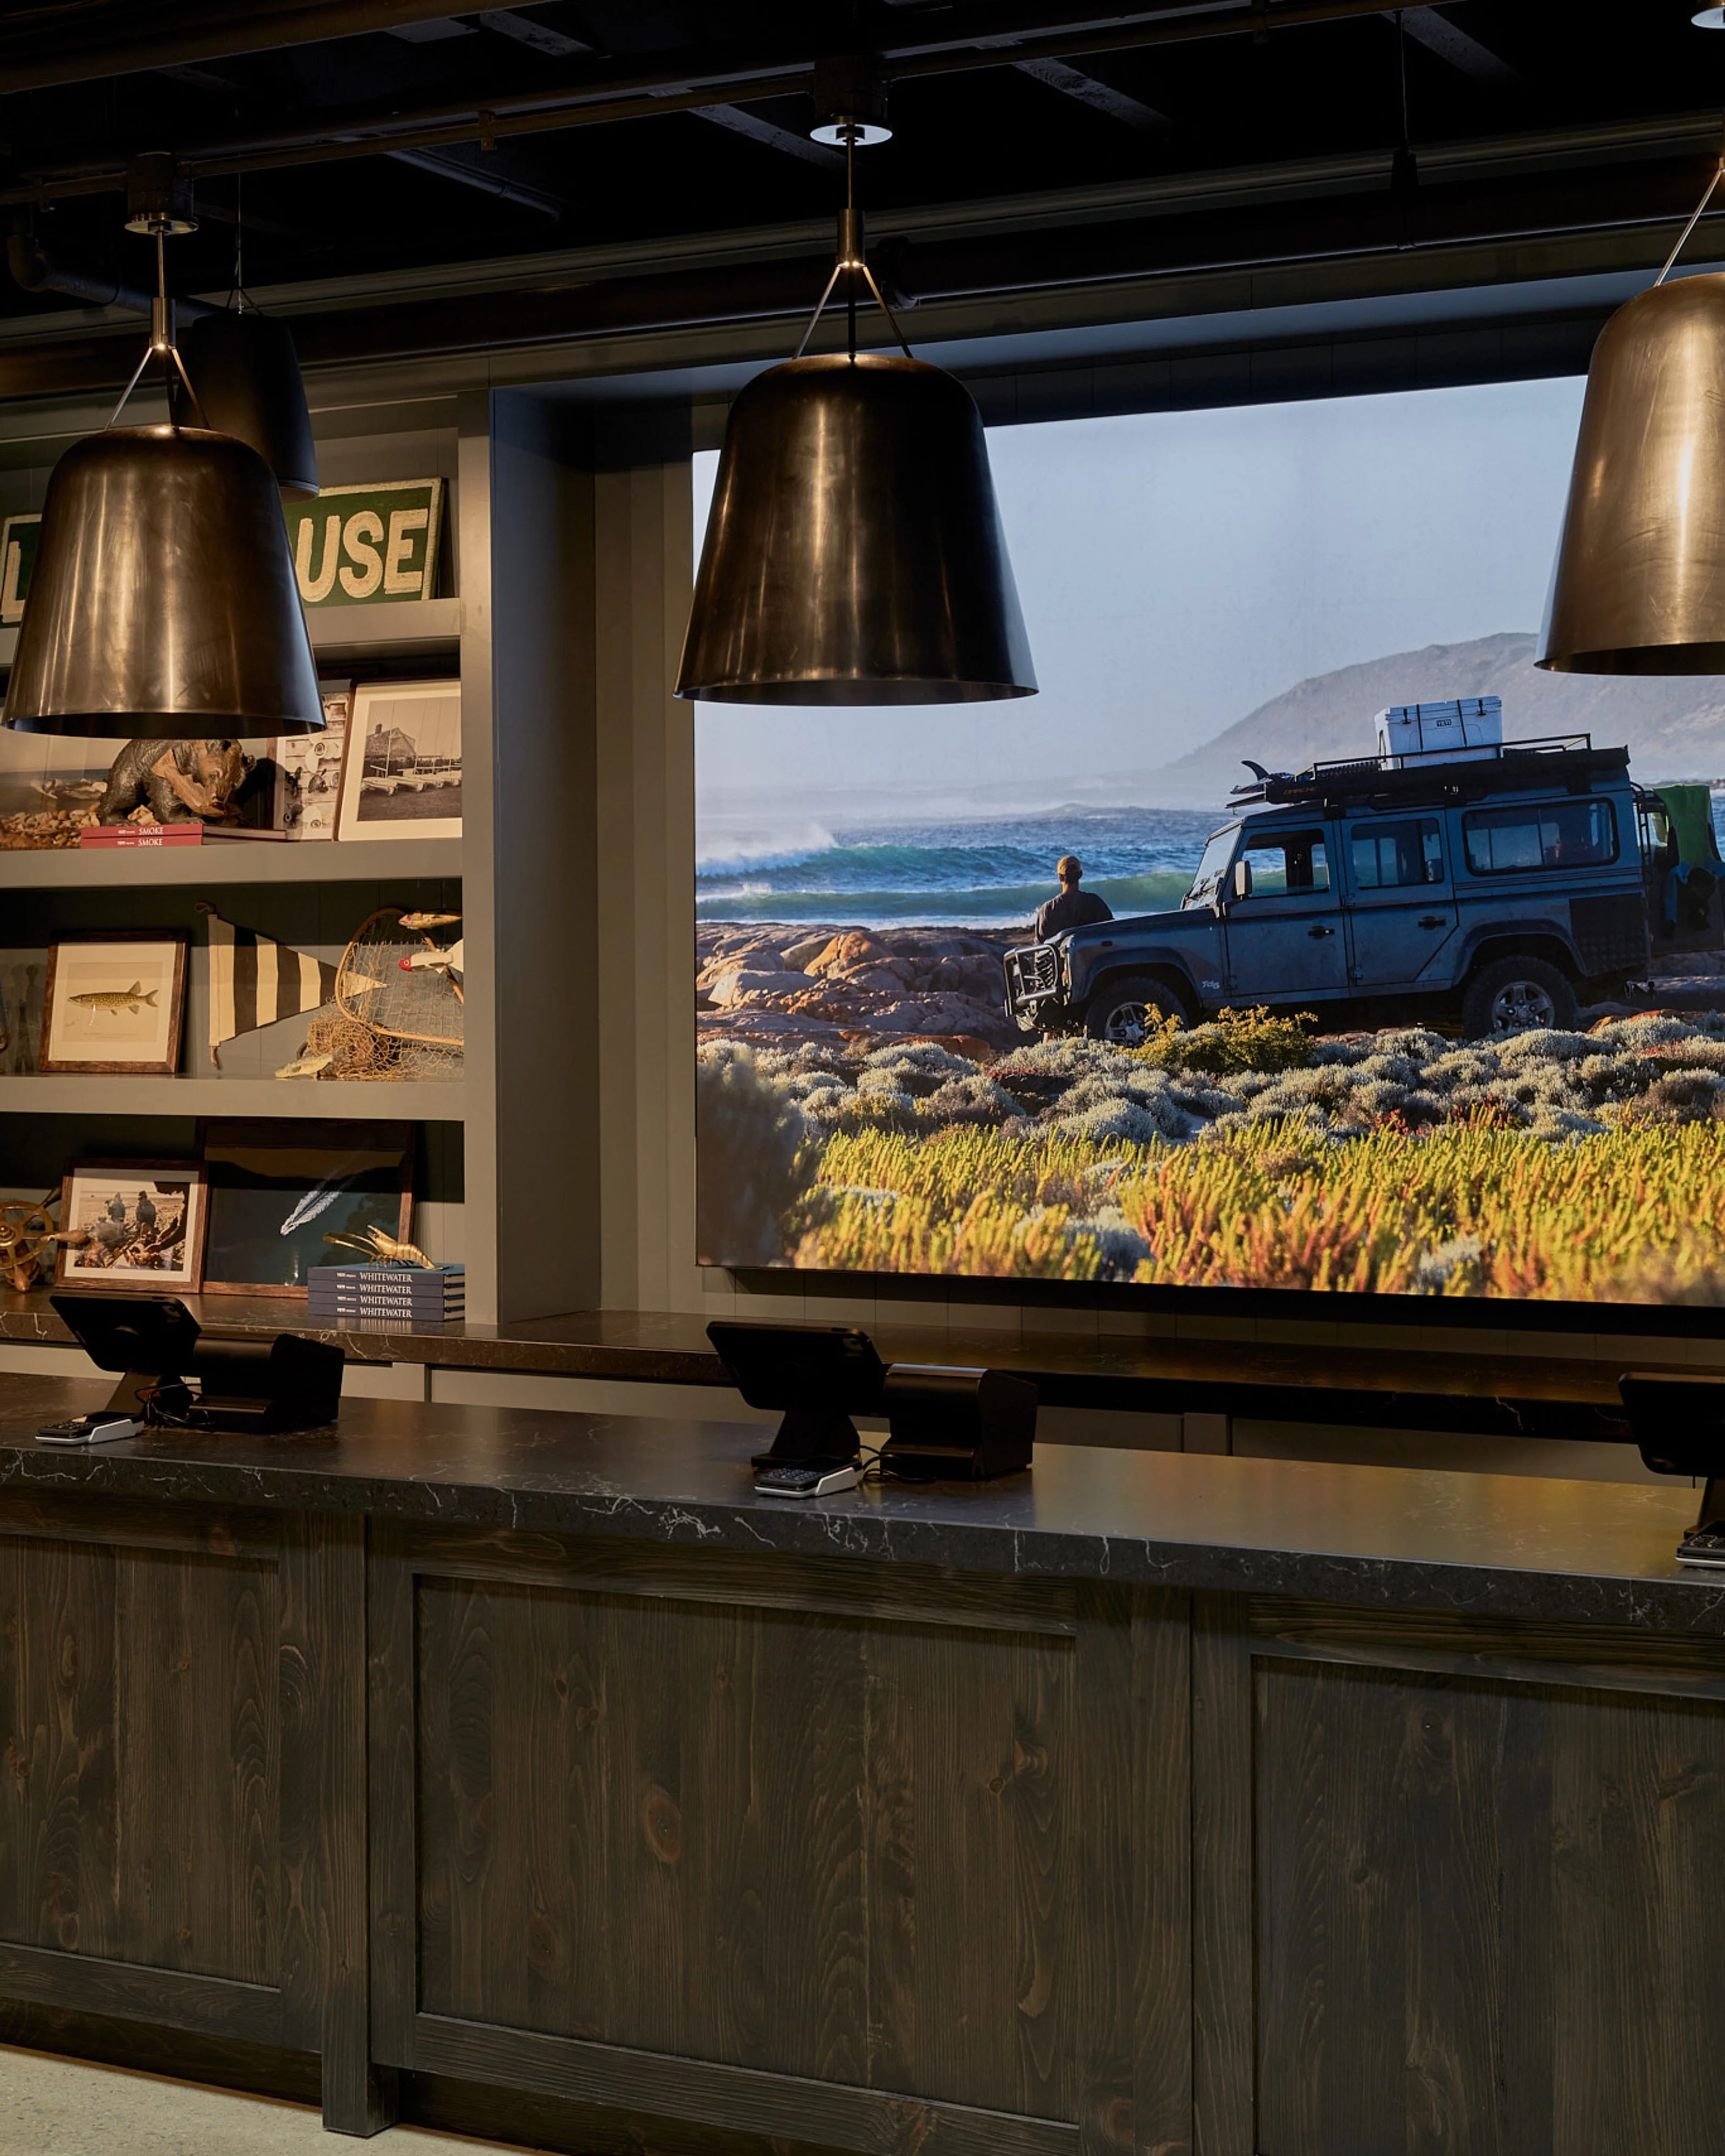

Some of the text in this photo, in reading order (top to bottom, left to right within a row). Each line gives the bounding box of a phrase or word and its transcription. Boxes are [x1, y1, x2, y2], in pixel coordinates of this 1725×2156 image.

[139, 827, 163, 835] SMOKE
[138, 838, 163, 847] SMOKE
[360, 1272, 412, 1282] WHITEWATER
[359, 1284, 412, 1294] WHITEWATER
[360, 1295, 412, 1306] WHITEWATER
[359, 1307, 412, 1318] WHITEWATER
